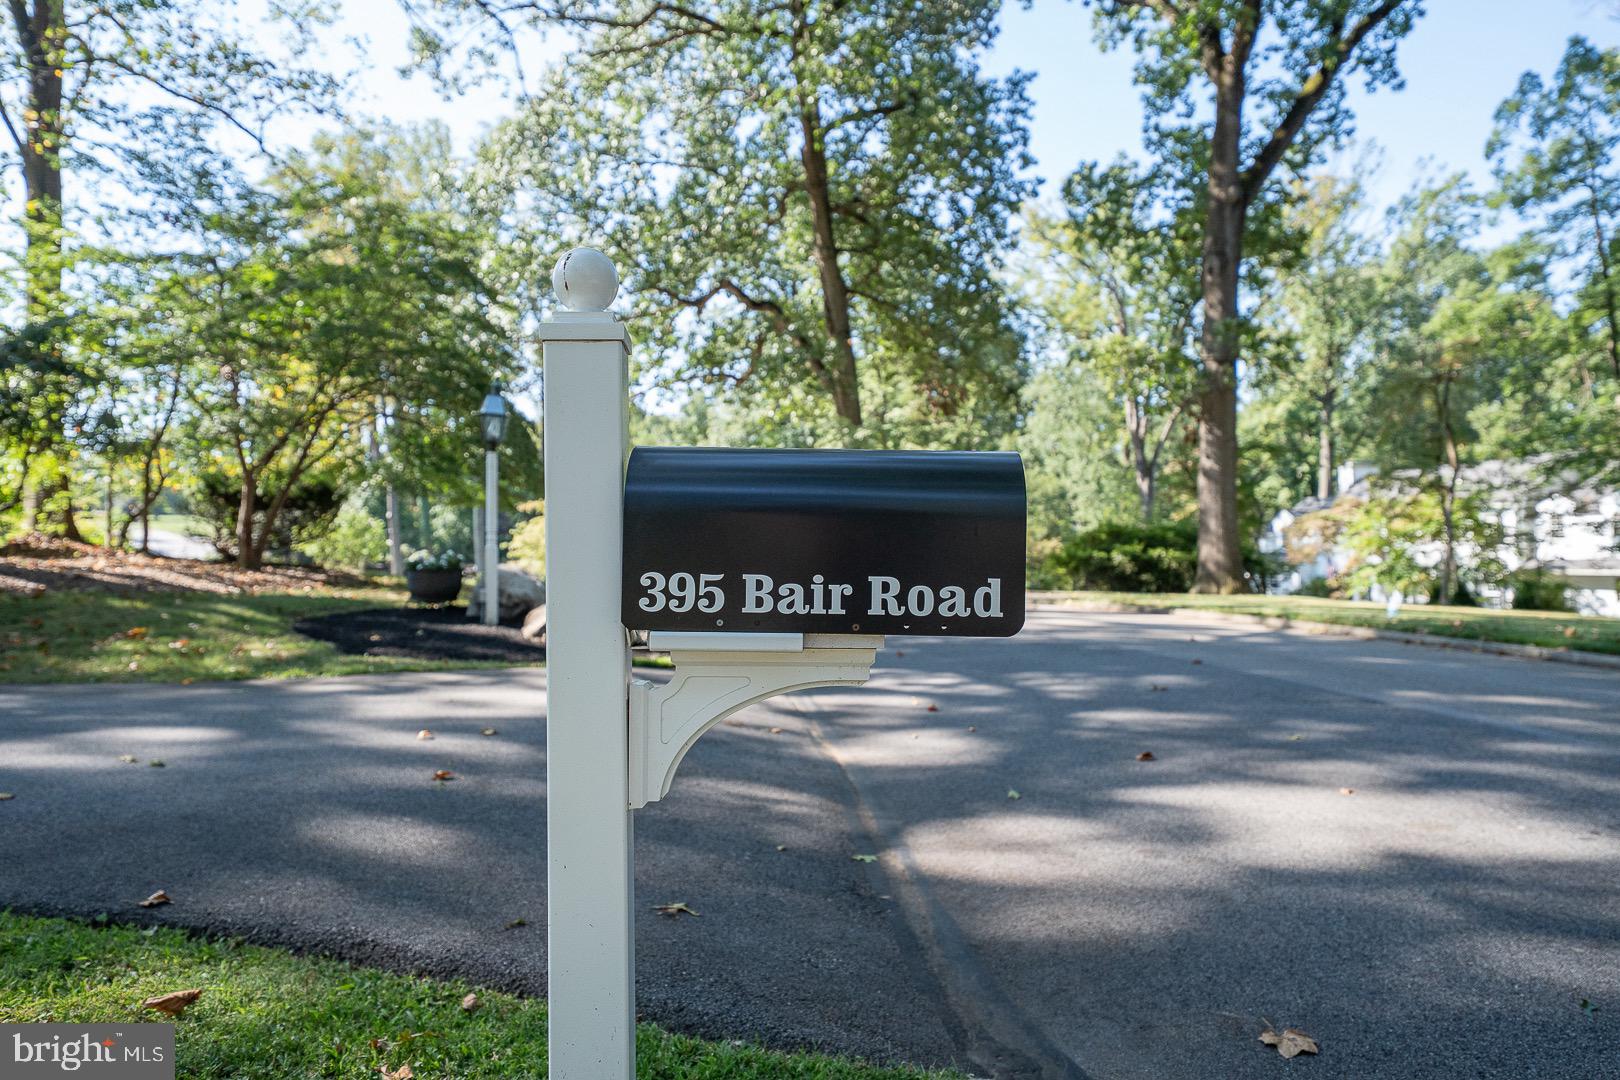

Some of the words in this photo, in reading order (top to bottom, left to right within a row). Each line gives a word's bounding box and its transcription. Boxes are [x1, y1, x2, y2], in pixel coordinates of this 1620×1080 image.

[638, 572, 725, 613] 395
[742, 574, 853, 615] Bair
[867, 576, 1004, 618] Road
